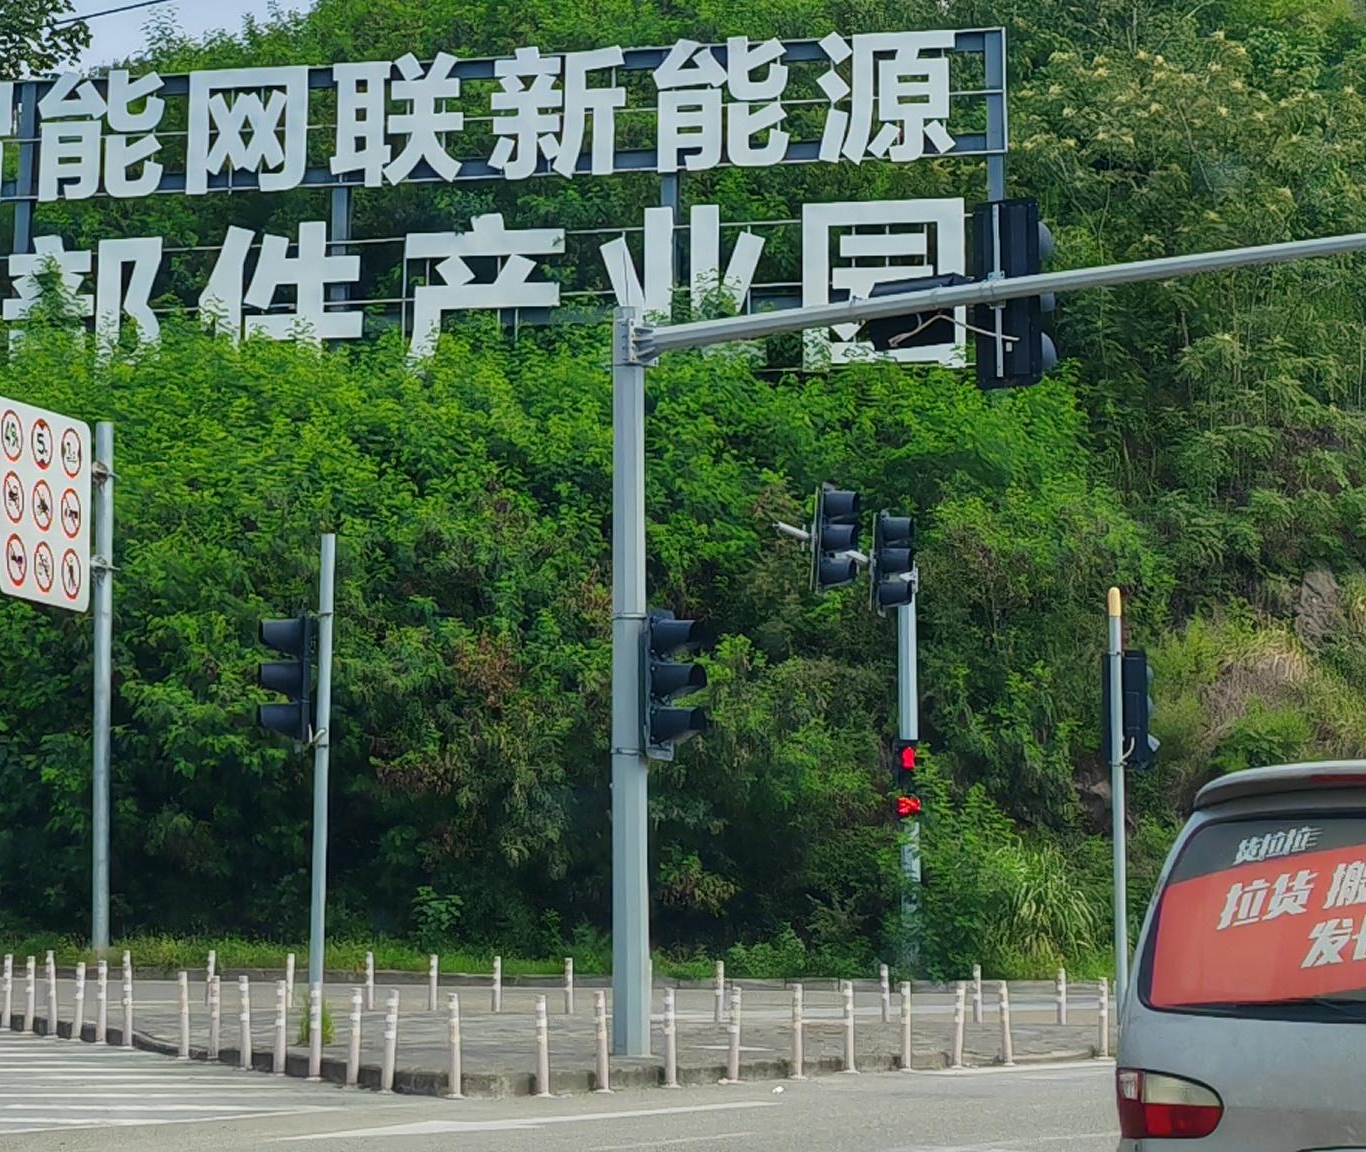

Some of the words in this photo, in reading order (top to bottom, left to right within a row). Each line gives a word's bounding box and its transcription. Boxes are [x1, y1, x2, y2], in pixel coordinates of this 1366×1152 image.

[1232, 826, 1323, 866] 货拉拉
[1216, 869, 1318, 931] 拉货
